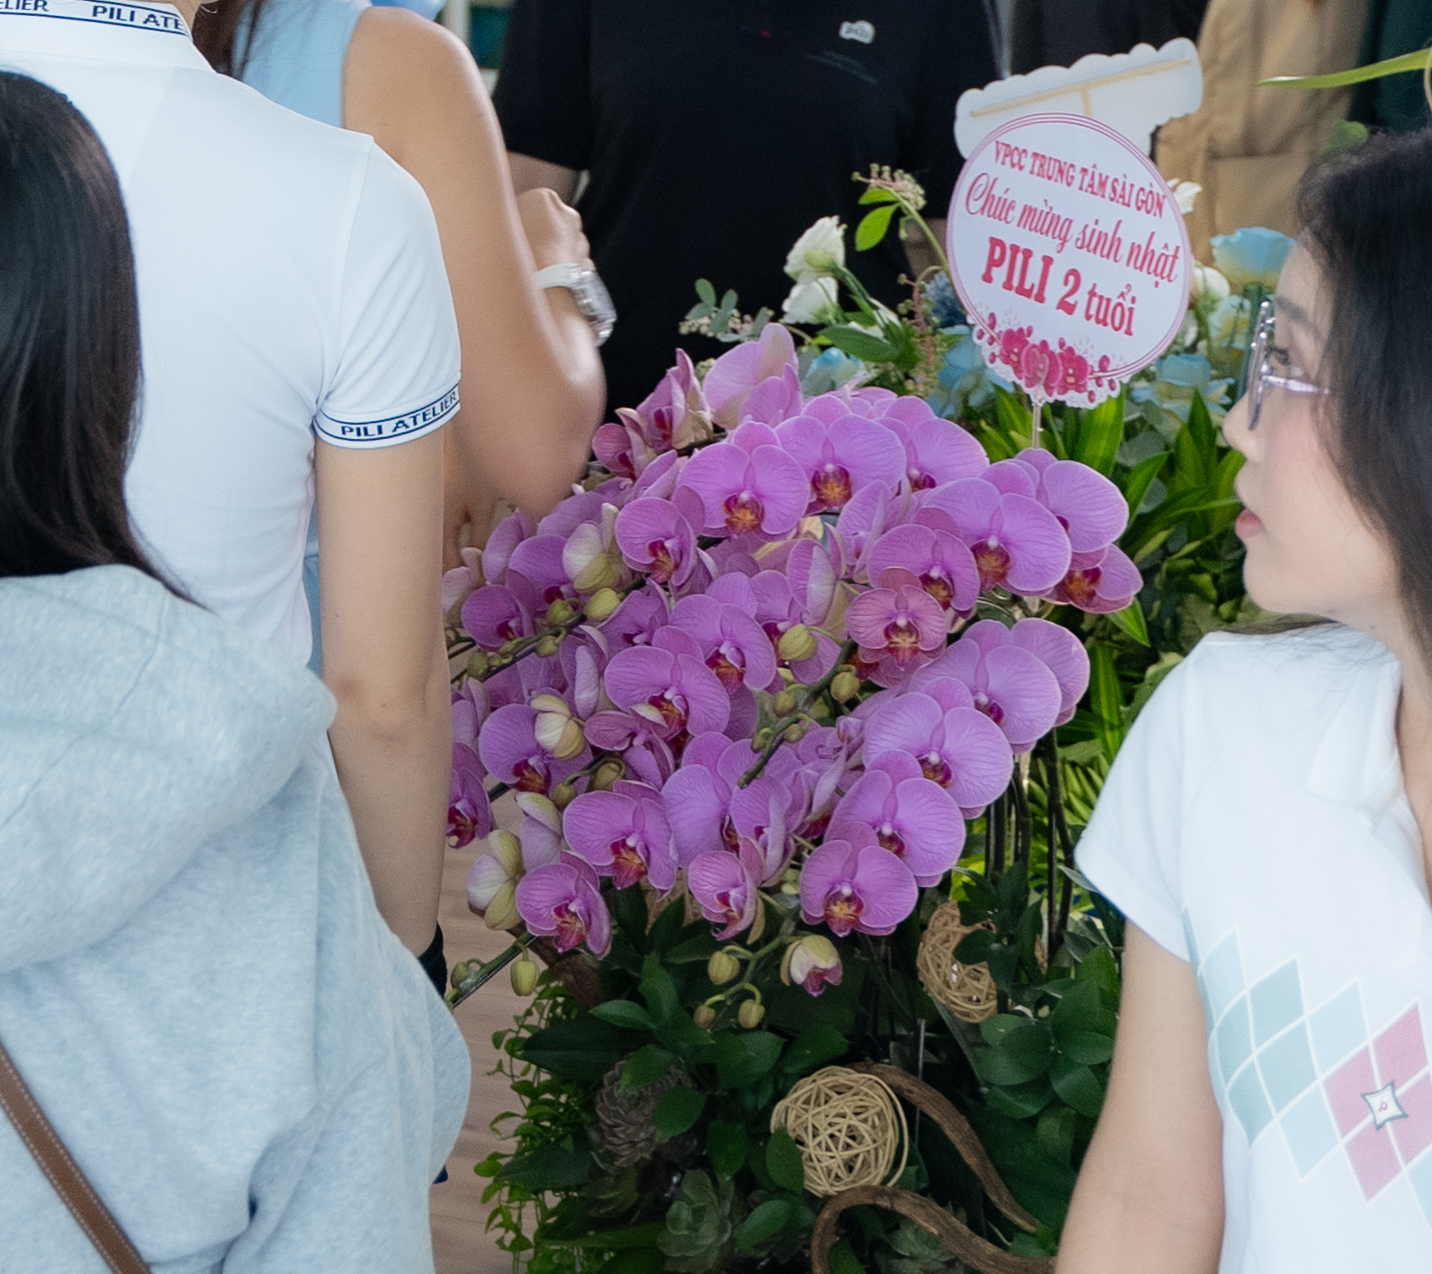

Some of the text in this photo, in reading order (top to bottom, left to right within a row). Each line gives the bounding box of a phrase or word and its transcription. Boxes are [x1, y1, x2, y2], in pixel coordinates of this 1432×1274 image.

[91, 5, 135, 23] PILI
[994, 140, 1168, 220] VPCC TRUNG TÂM SÀI GÒN
[965, 172, 1182, 289] Chúc mừng sinh nhật
[982, 237, 1138, 337] PILI 2 tuổi
[340, 390, 458, 438] PILI ATELIER
